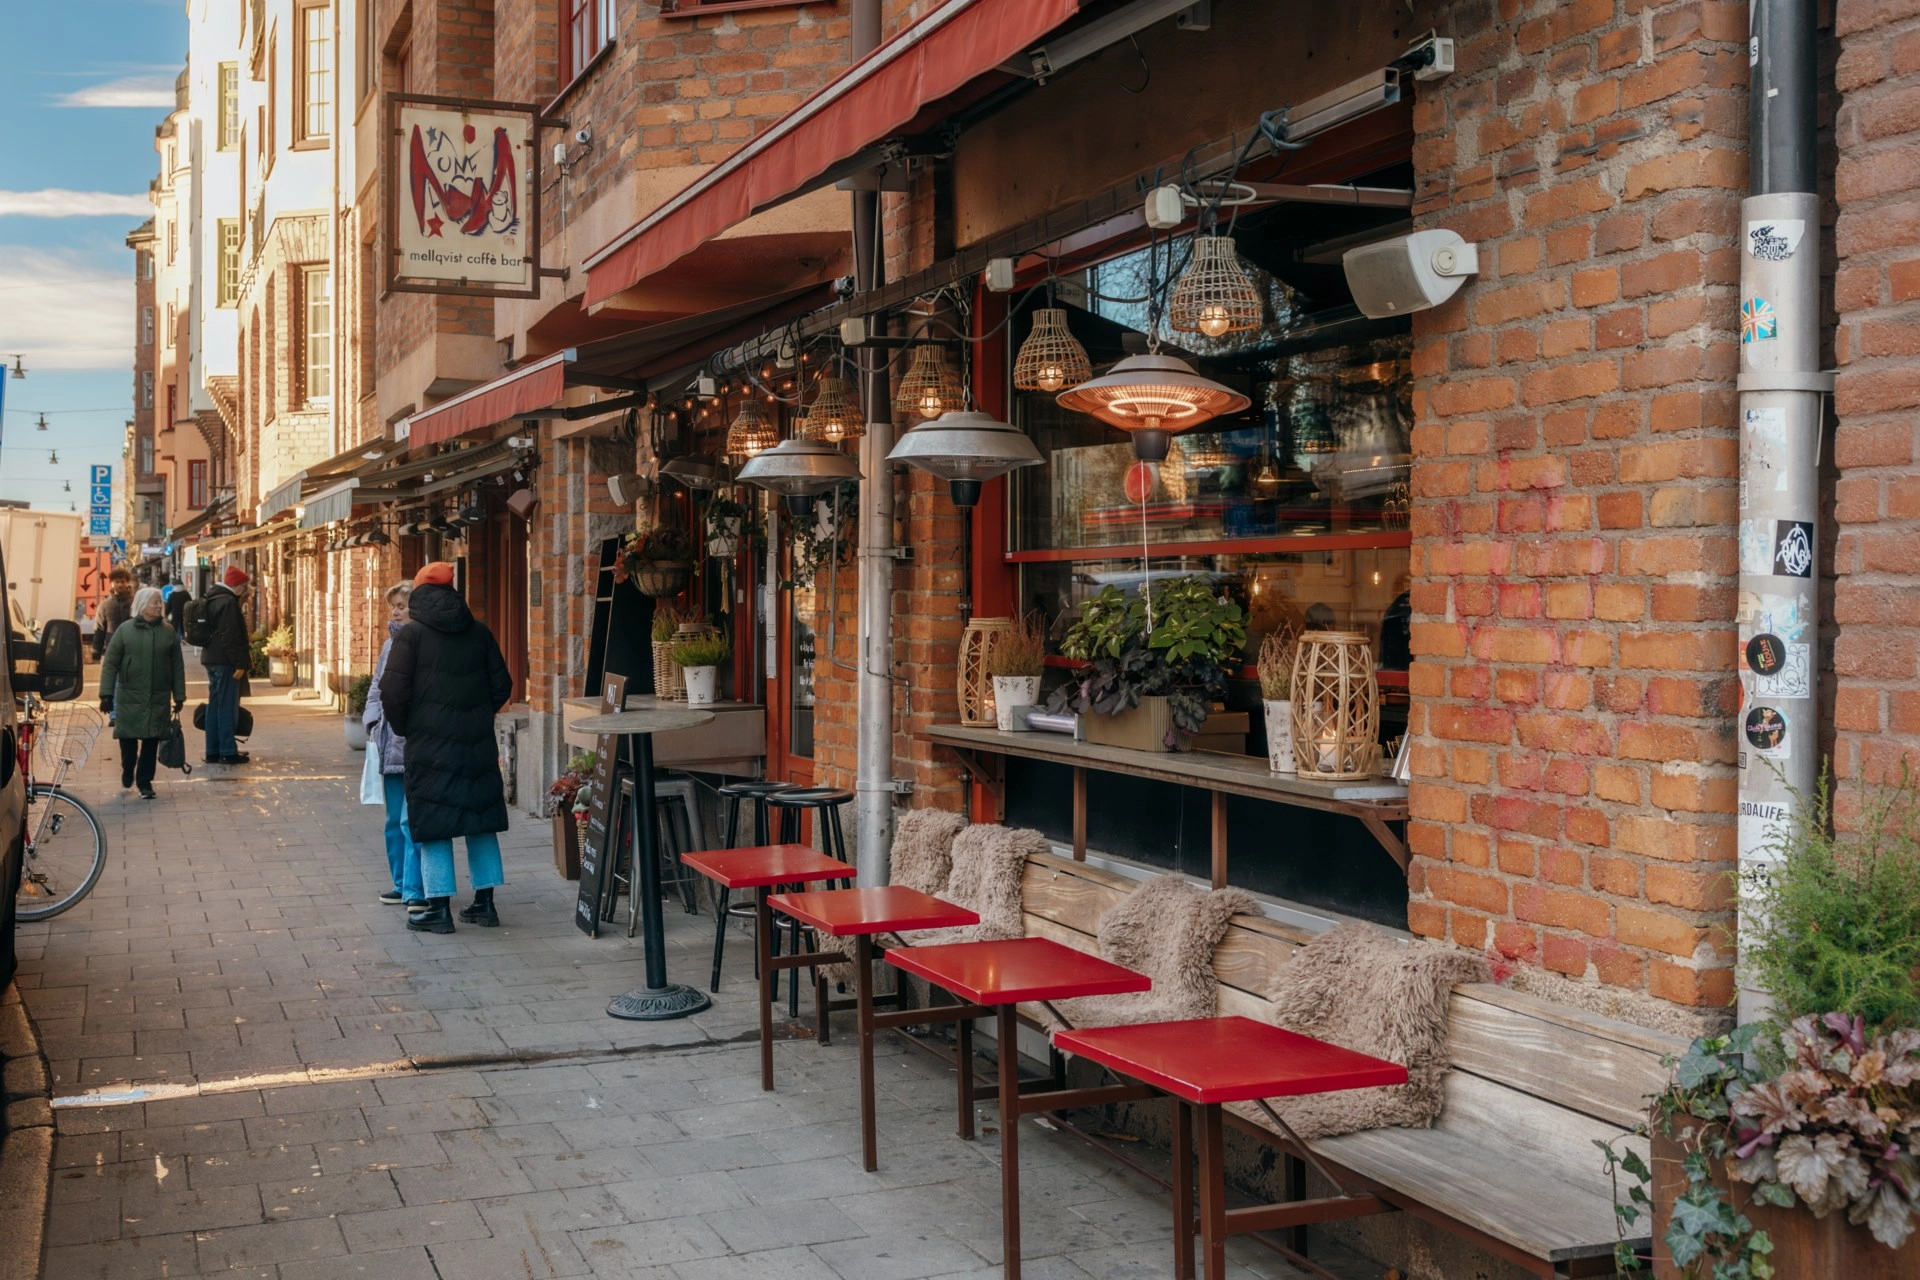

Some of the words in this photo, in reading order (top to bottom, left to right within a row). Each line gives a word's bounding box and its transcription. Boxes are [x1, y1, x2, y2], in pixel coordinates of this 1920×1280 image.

[410, 249, 463, 266] mellqvist
[467, 252, 497, 266] caffè
[501, 254, 522, 267] bar
[96, 467, 108, 483] P
